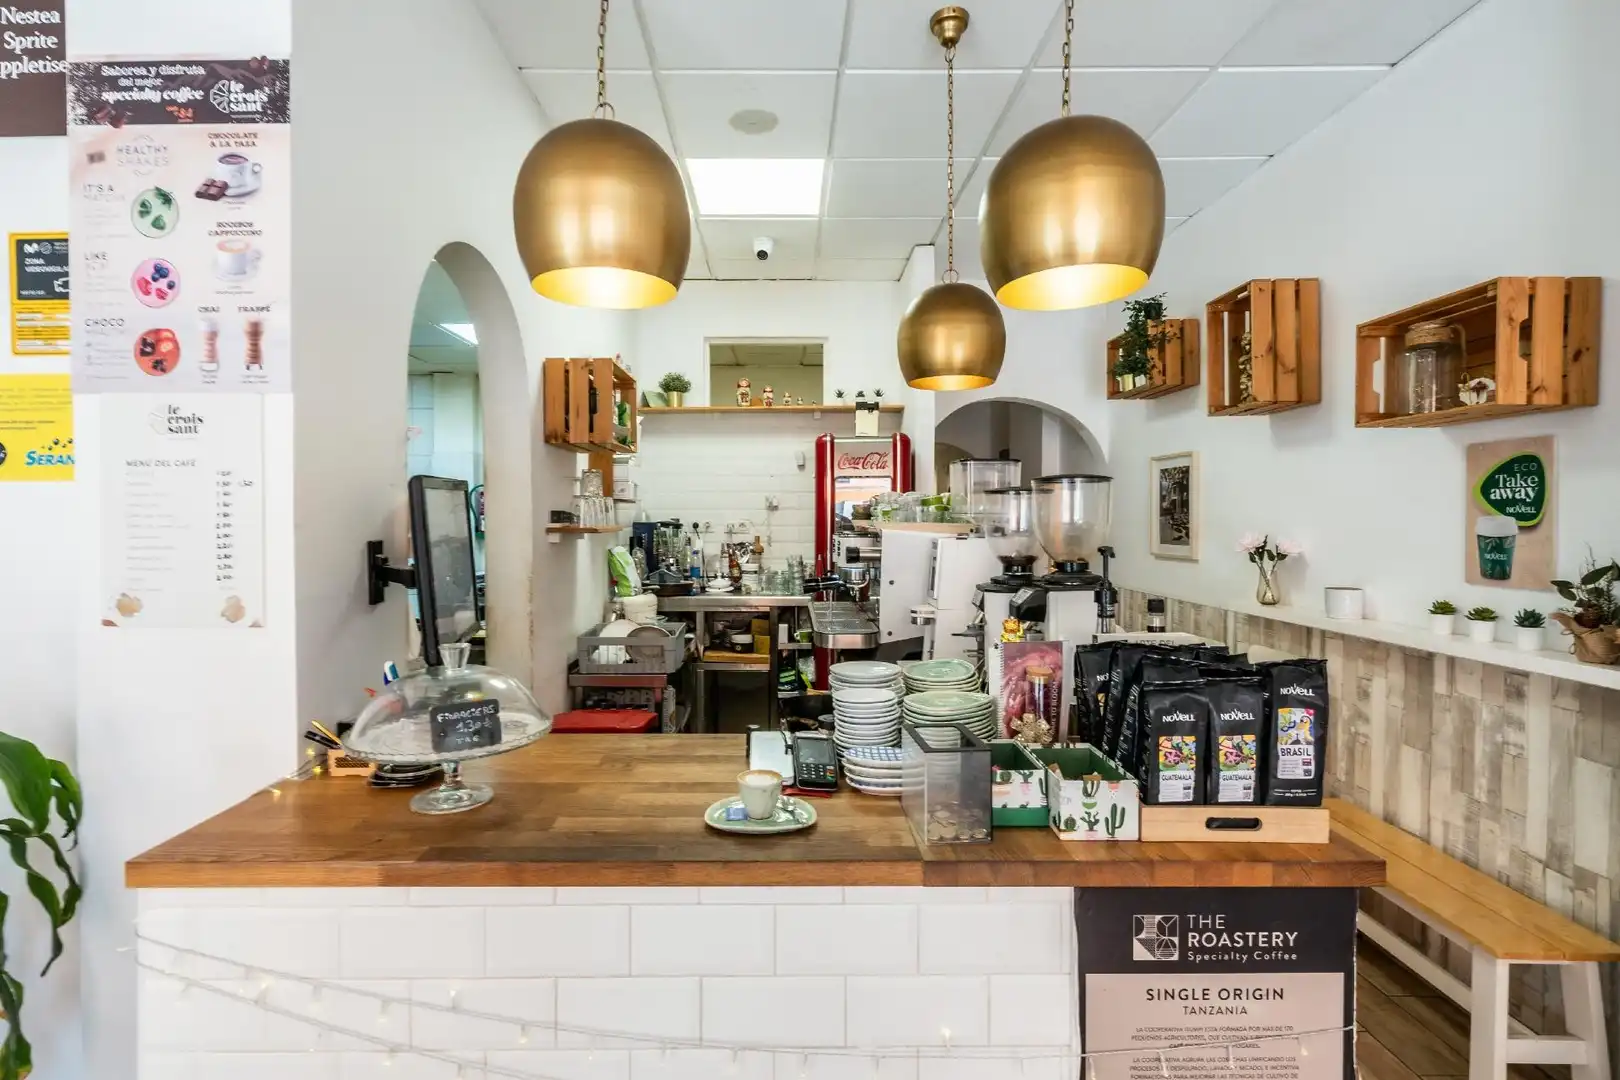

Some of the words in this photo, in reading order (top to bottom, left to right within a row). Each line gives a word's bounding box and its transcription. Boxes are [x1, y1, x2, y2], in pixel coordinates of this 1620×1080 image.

[0, 6, 61, 24] Nestea
[3, 31, 58, 54] Sprite
[0, 55, 69, 79] ppletise
[117, 144, 169, 155] HEALTHY
[167, 413, 204, 424] crois
[1514, 463, 1537, 472] ECO
[1495, 474, 1538, 487] Take
[1490, 487, 1539, 501] away
[1280, 748, 1312, 757] BRASIL
[1187, 914, 1227, 929] THE
[1187, 932, 1298, 947] ROASTERY
[1187, 951, 1248, 963] Specialty
[1254, 951, 1298, 960] Coffee
[1146, 988, 1211, 1001] SINGLE
[1218, 988, 1285, 1001] ORIGIN
[1182, 1006, 1248, 1015] TANZANIA
